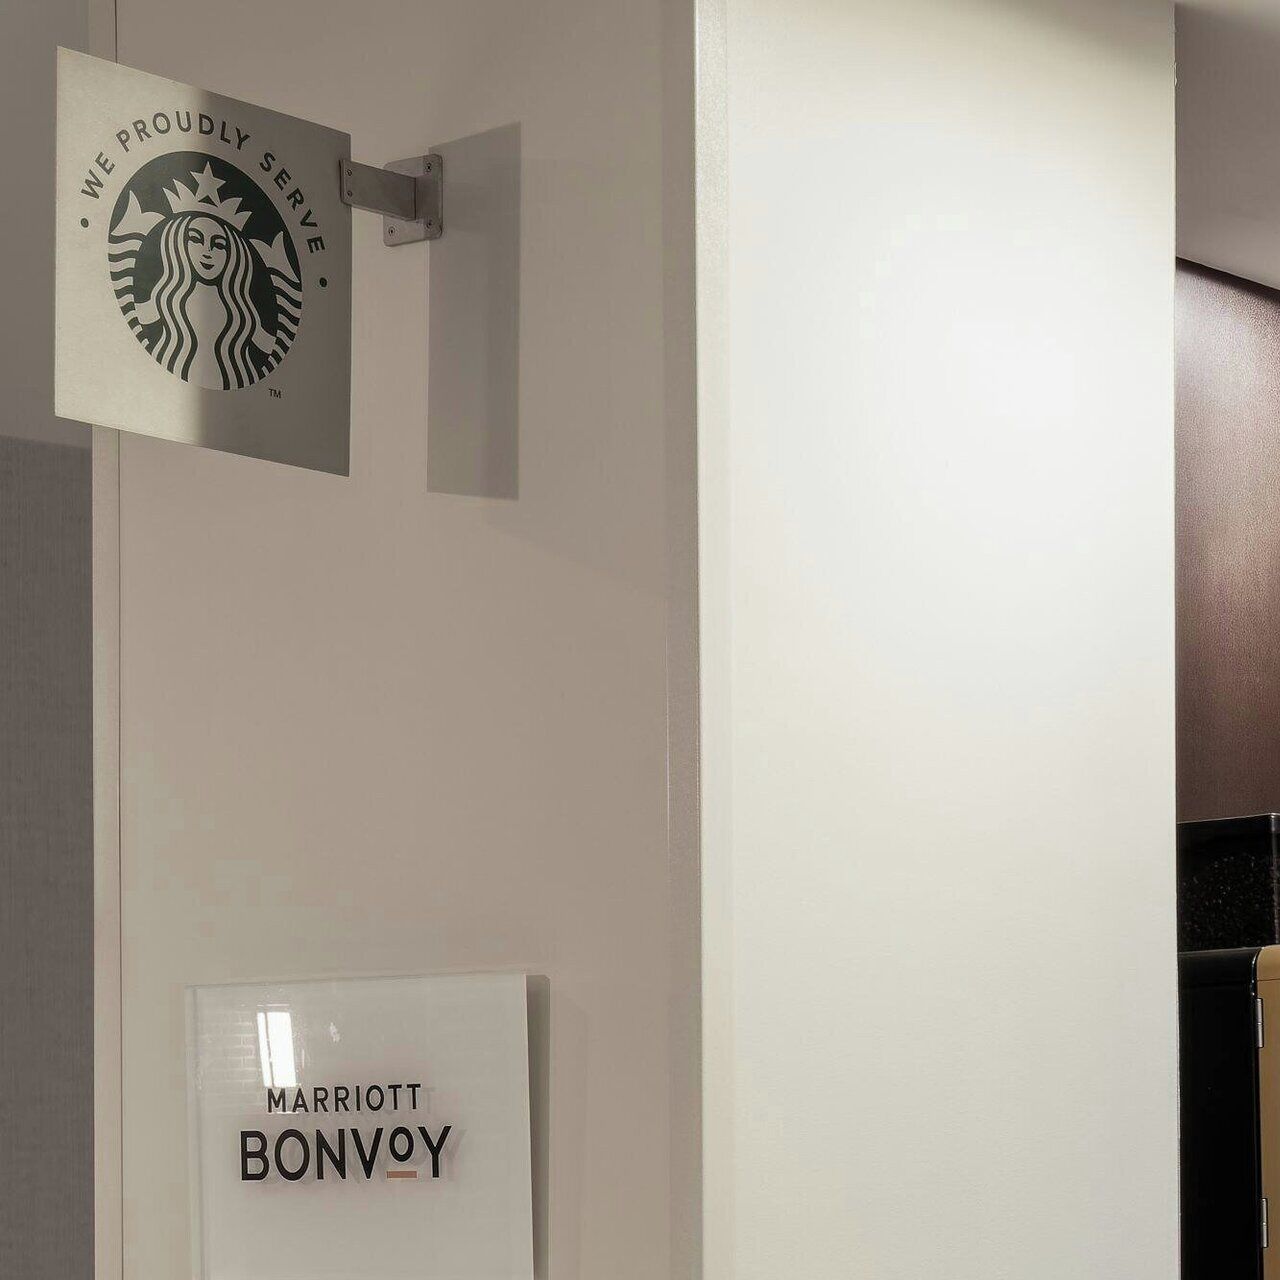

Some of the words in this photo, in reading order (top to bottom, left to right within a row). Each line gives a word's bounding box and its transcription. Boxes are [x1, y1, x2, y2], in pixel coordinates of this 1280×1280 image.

[81, 152, 116, 201] WE
[116, 110, 250, 153] PROUDLY
[259, 152, 325, 254] SERVE
[267, 1083, 421, 1114] MARRIOTT
[240, 1125, 452, 1182] BONVOY
